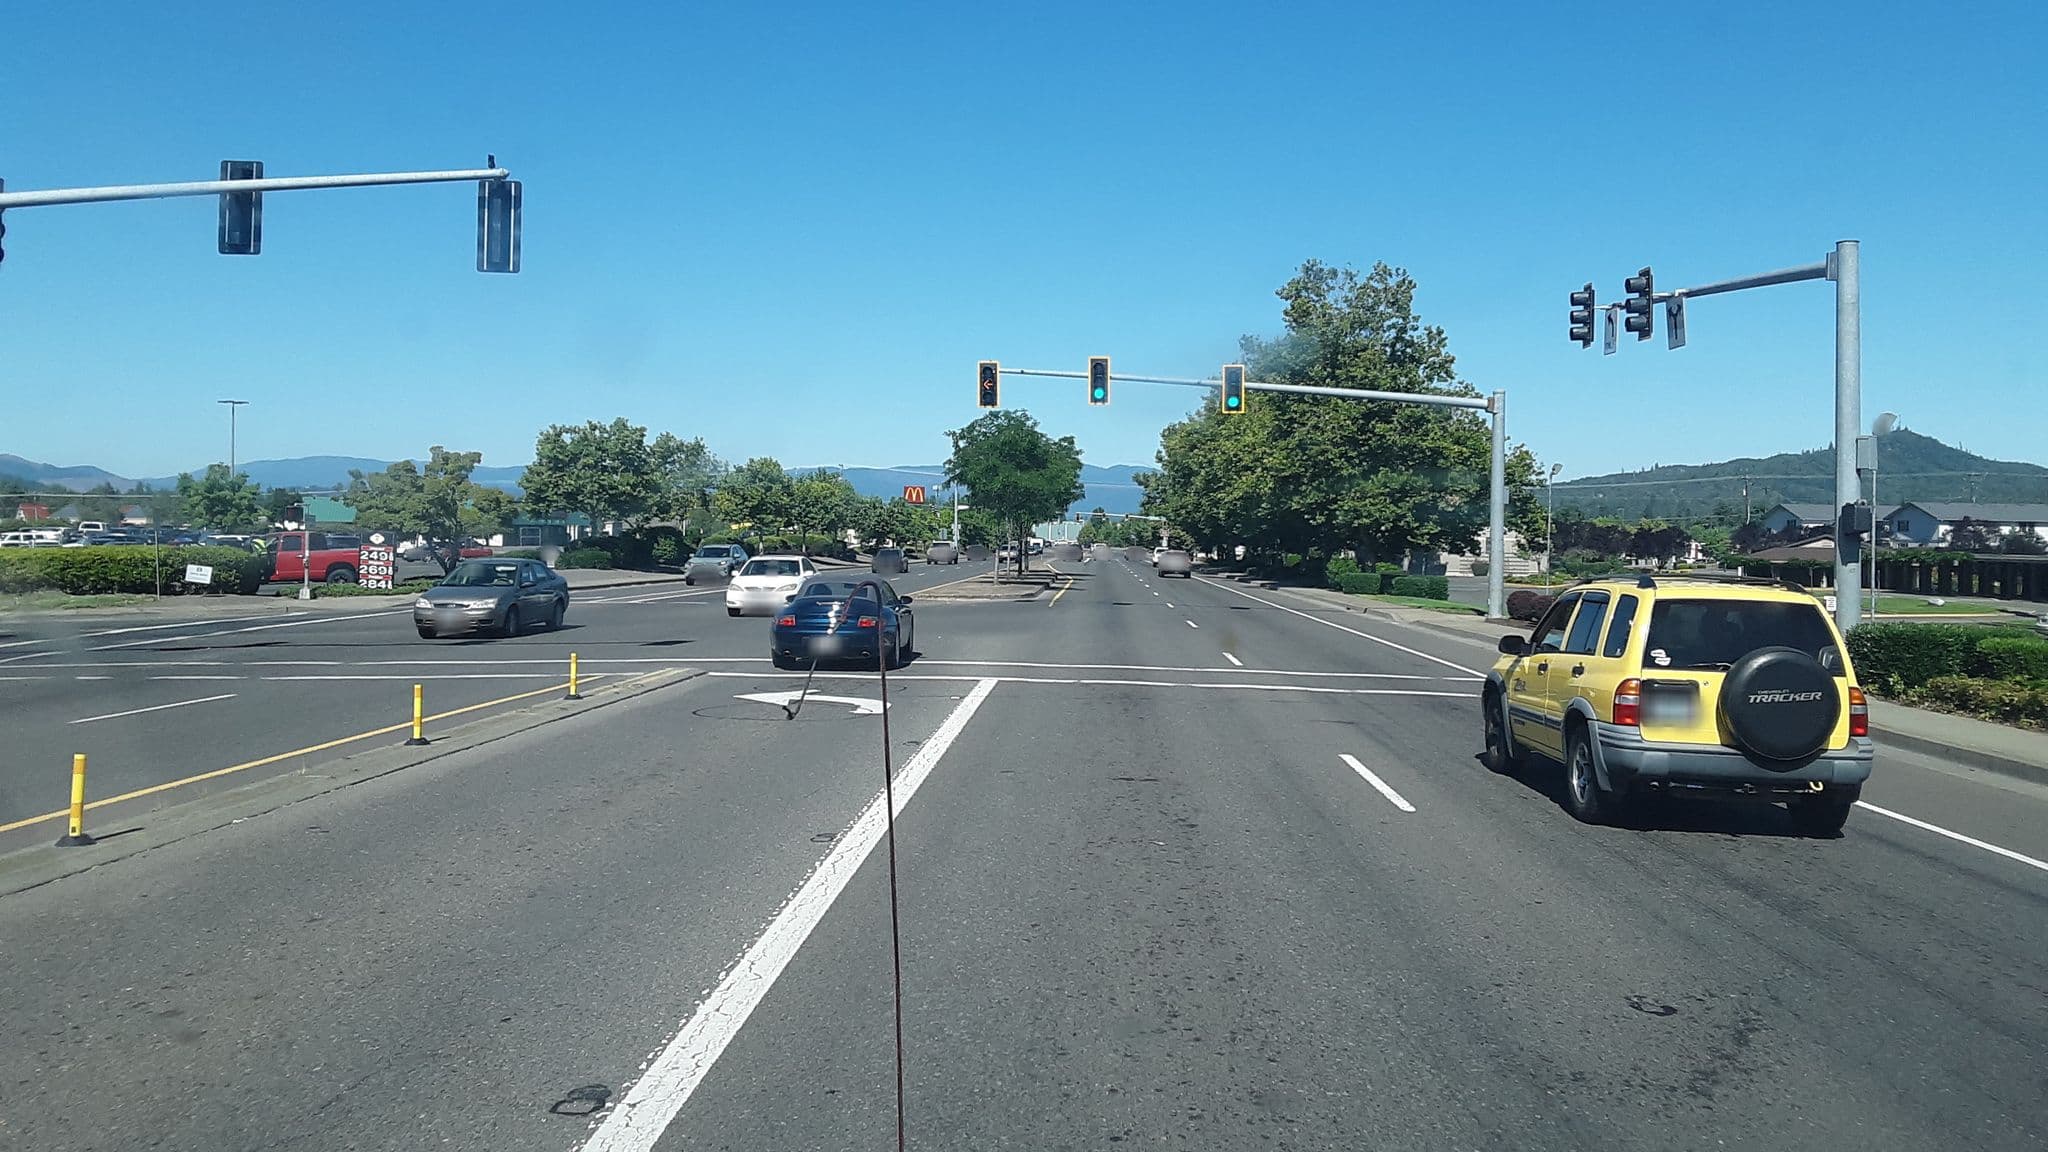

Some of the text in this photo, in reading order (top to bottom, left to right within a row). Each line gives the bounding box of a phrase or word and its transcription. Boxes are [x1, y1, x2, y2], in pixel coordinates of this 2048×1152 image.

[360, 550, 388, 560] 249
[359, 565, 388, 575] 269
[1748, 692, 1823, 703] TRACKER
